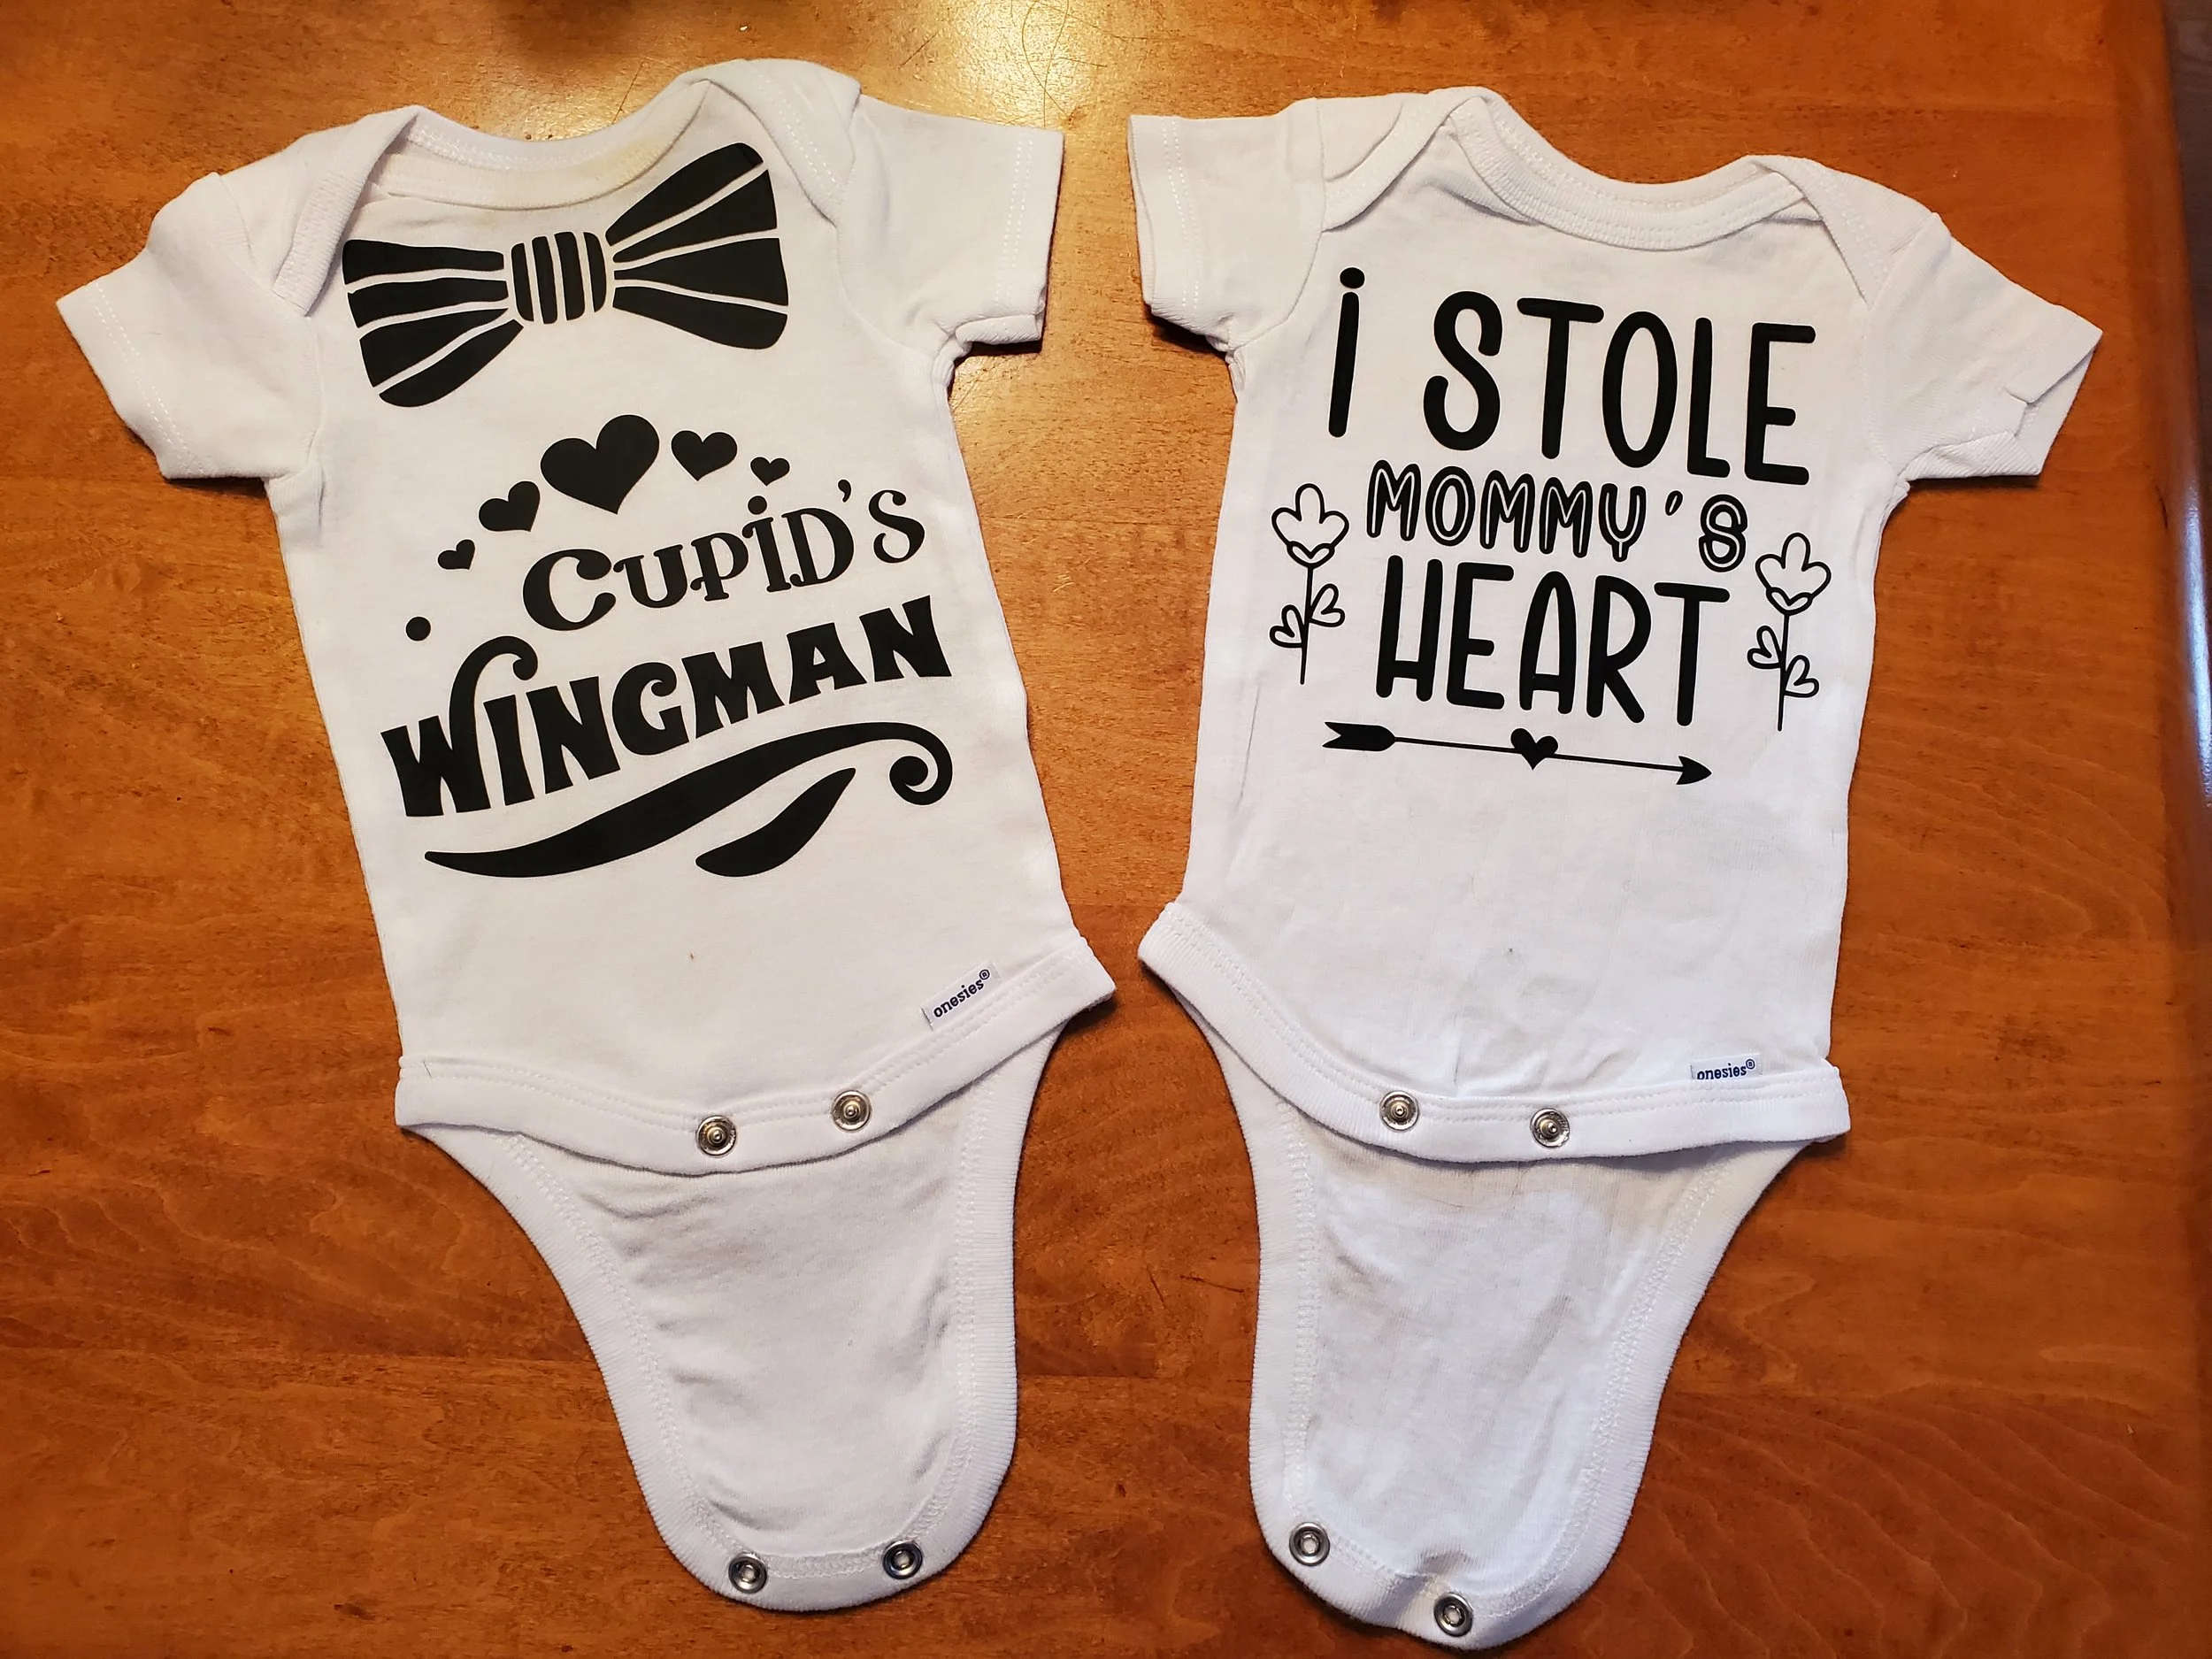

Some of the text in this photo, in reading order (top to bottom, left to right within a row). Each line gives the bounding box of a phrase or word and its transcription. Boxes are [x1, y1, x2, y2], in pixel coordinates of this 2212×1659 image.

[1423, 290, 1816, 486] STOLE
[1366, 459, 1748, 573] MOMMY'S
[380, 595, 953, 818] WINGMAN
[1375, 555, 1731, 726] HEART
